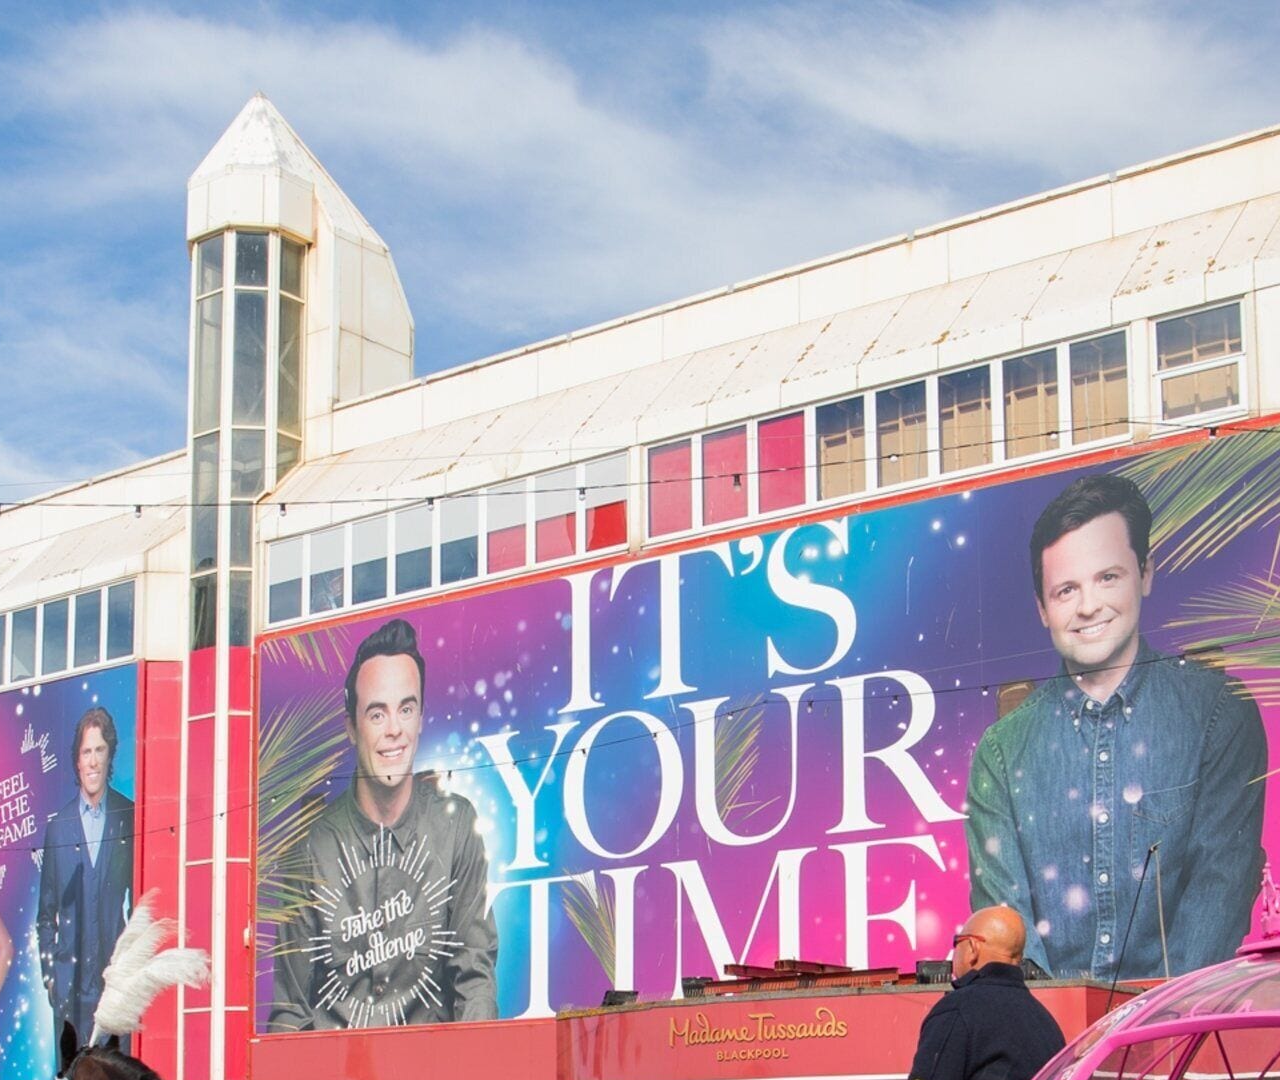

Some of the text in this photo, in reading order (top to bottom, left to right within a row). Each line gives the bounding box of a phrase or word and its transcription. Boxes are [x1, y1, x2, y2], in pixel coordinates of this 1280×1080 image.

[475, 669, 969, 871] YOUR
[340, 889, 415, 943] Take the
[484, 834, 947, 1020] TIME
[346, 928, 426, 977] challenge
[669, 1007, 848, 1047] Madame Tussauds
[716, 1048, 789, 1062] BLACKPOOL
